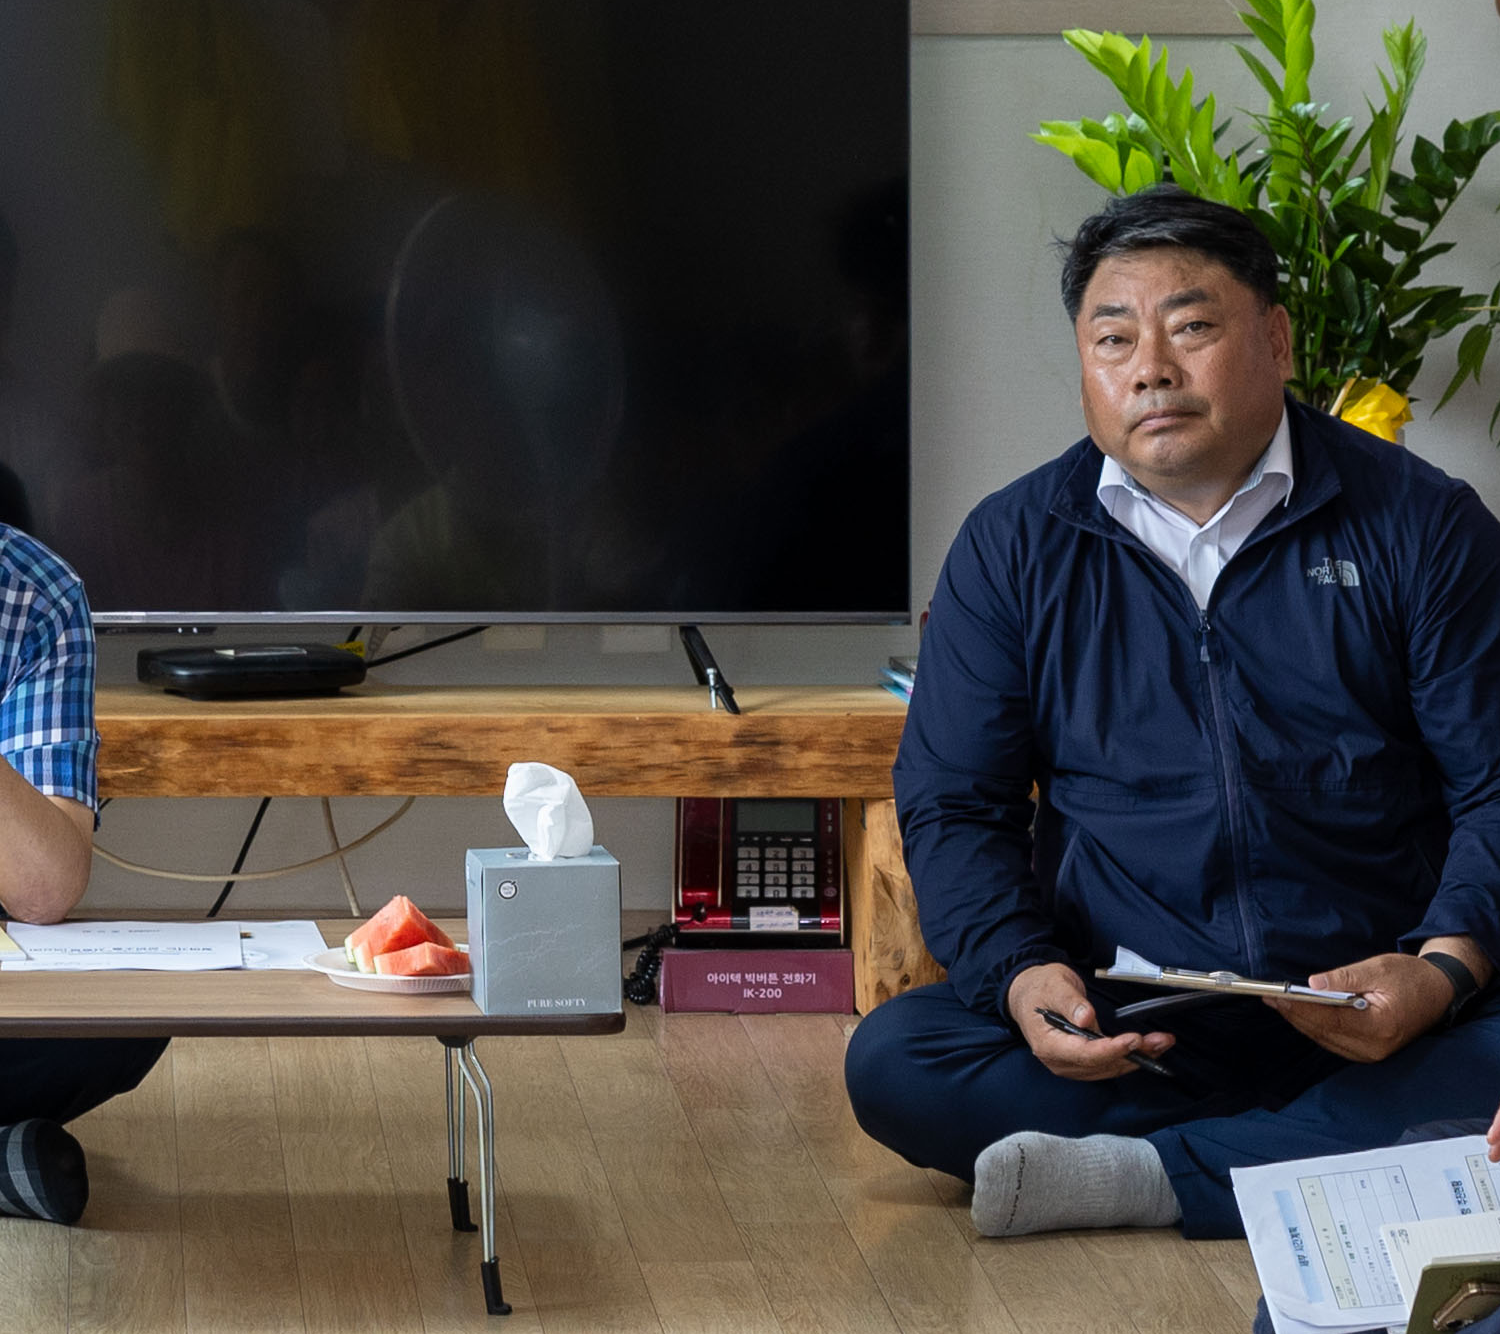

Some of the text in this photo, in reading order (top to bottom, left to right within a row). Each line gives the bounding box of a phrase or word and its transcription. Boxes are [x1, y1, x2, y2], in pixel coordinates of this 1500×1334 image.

[782, 973, 817, 985] 전화기
[743, 988, 782, 999] IK-200
[527, 998, 587, 1008] PURE SOFTY
